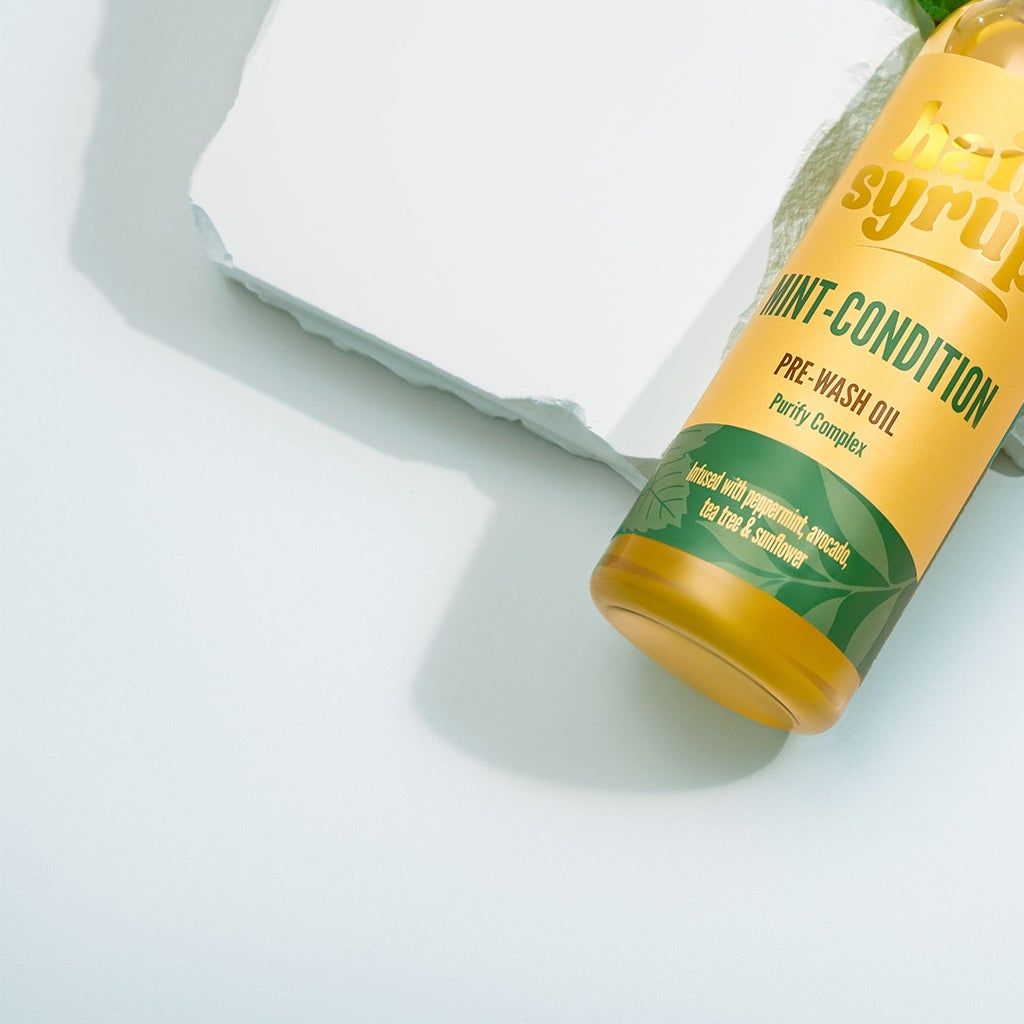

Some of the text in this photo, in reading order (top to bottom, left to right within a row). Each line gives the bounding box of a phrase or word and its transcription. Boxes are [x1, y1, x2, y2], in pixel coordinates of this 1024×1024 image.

[760, 274, 1000, 430] MINT-CONDITION
[773, 352, 901, 437] PRE-WASH OIL
[768, 392, 867, 458] Purify Complex
[685, 461, 851, 569] Infused with peppermint, avocado,
[699, 498, 808, 569] tea tree & sunflower
